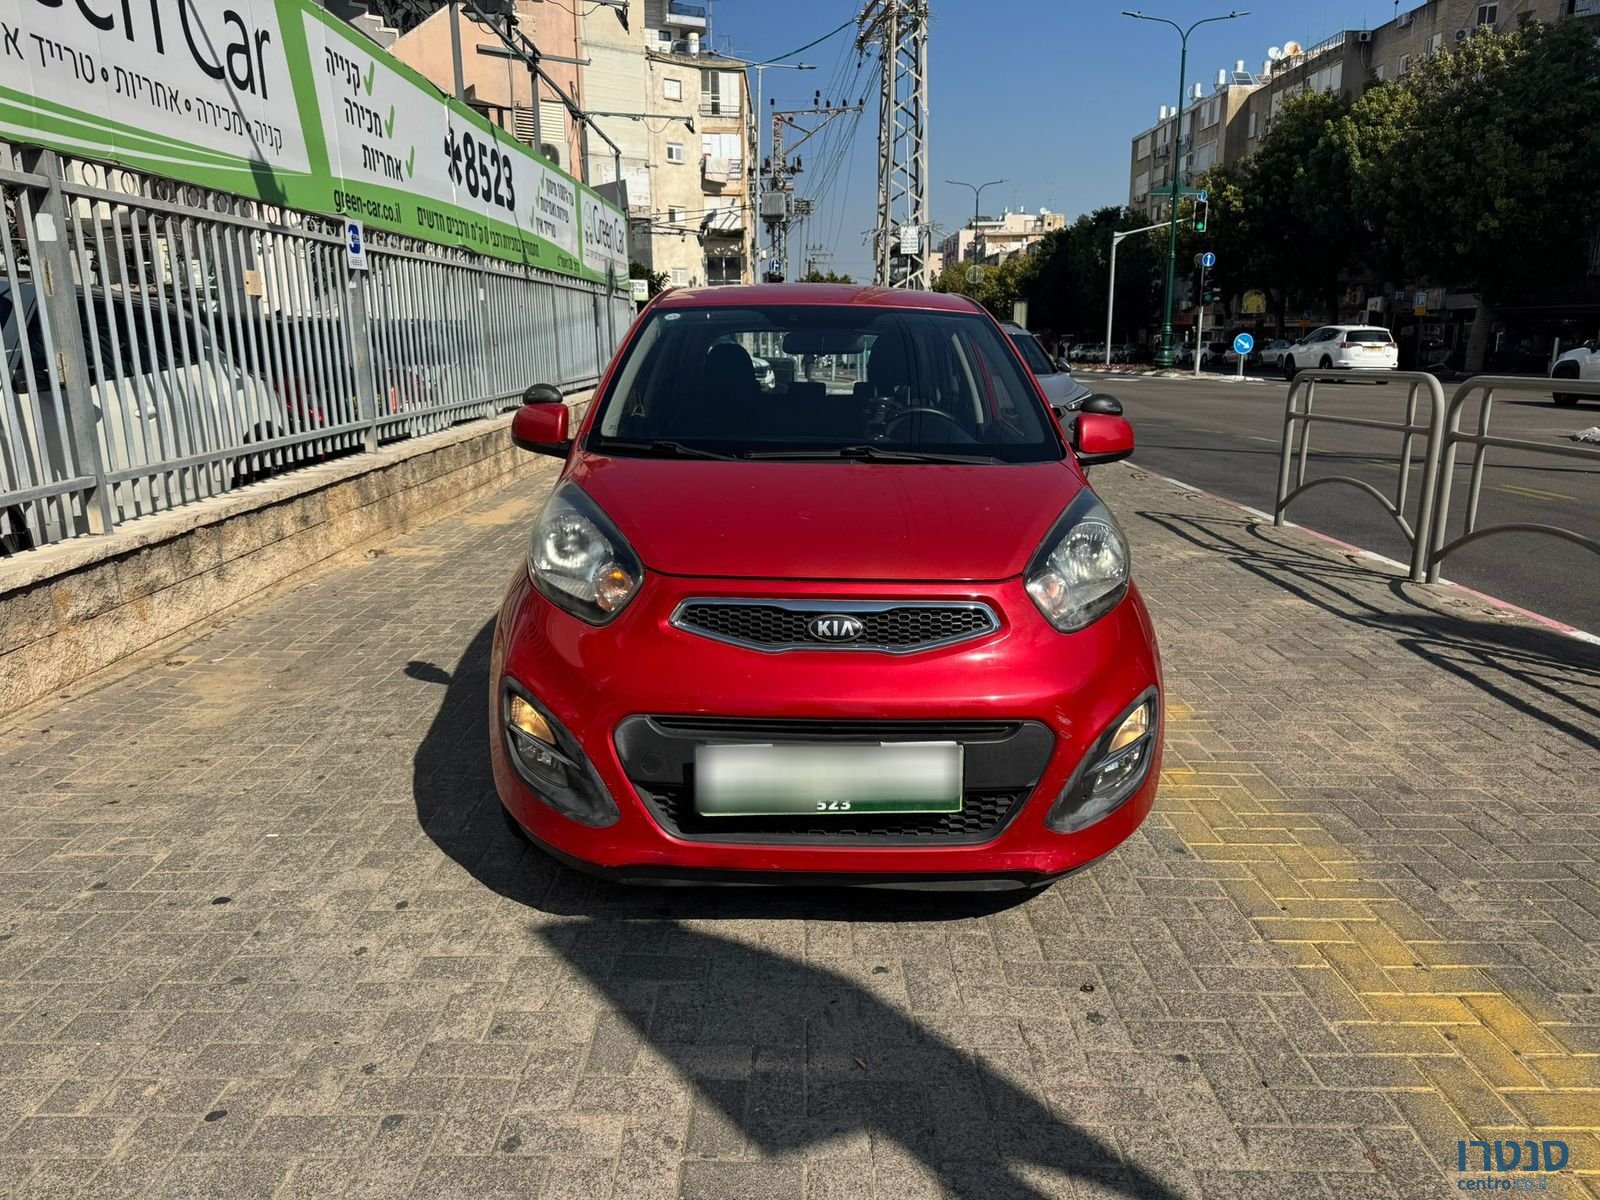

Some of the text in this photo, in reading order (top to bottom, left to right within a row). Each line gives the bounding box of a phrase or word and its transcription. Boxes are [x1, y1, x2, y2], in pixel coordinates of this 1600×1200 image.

[29, 32, 95, 84] טרייד
[325, 46, 361, 96] קנייה
[114, 65, 182, 116] אחריות
[196, 97, 244, 137] מכירה
[344, 97, 383, 139] מכירה
[254, 119, 284, 156] קניה
[362, 143, 404, 182] אחריות
[333, 188, 402, 224] green-car.co.il
[416, 206, 446, 233] חדשים
[817, 621, 855, 636] KIA
